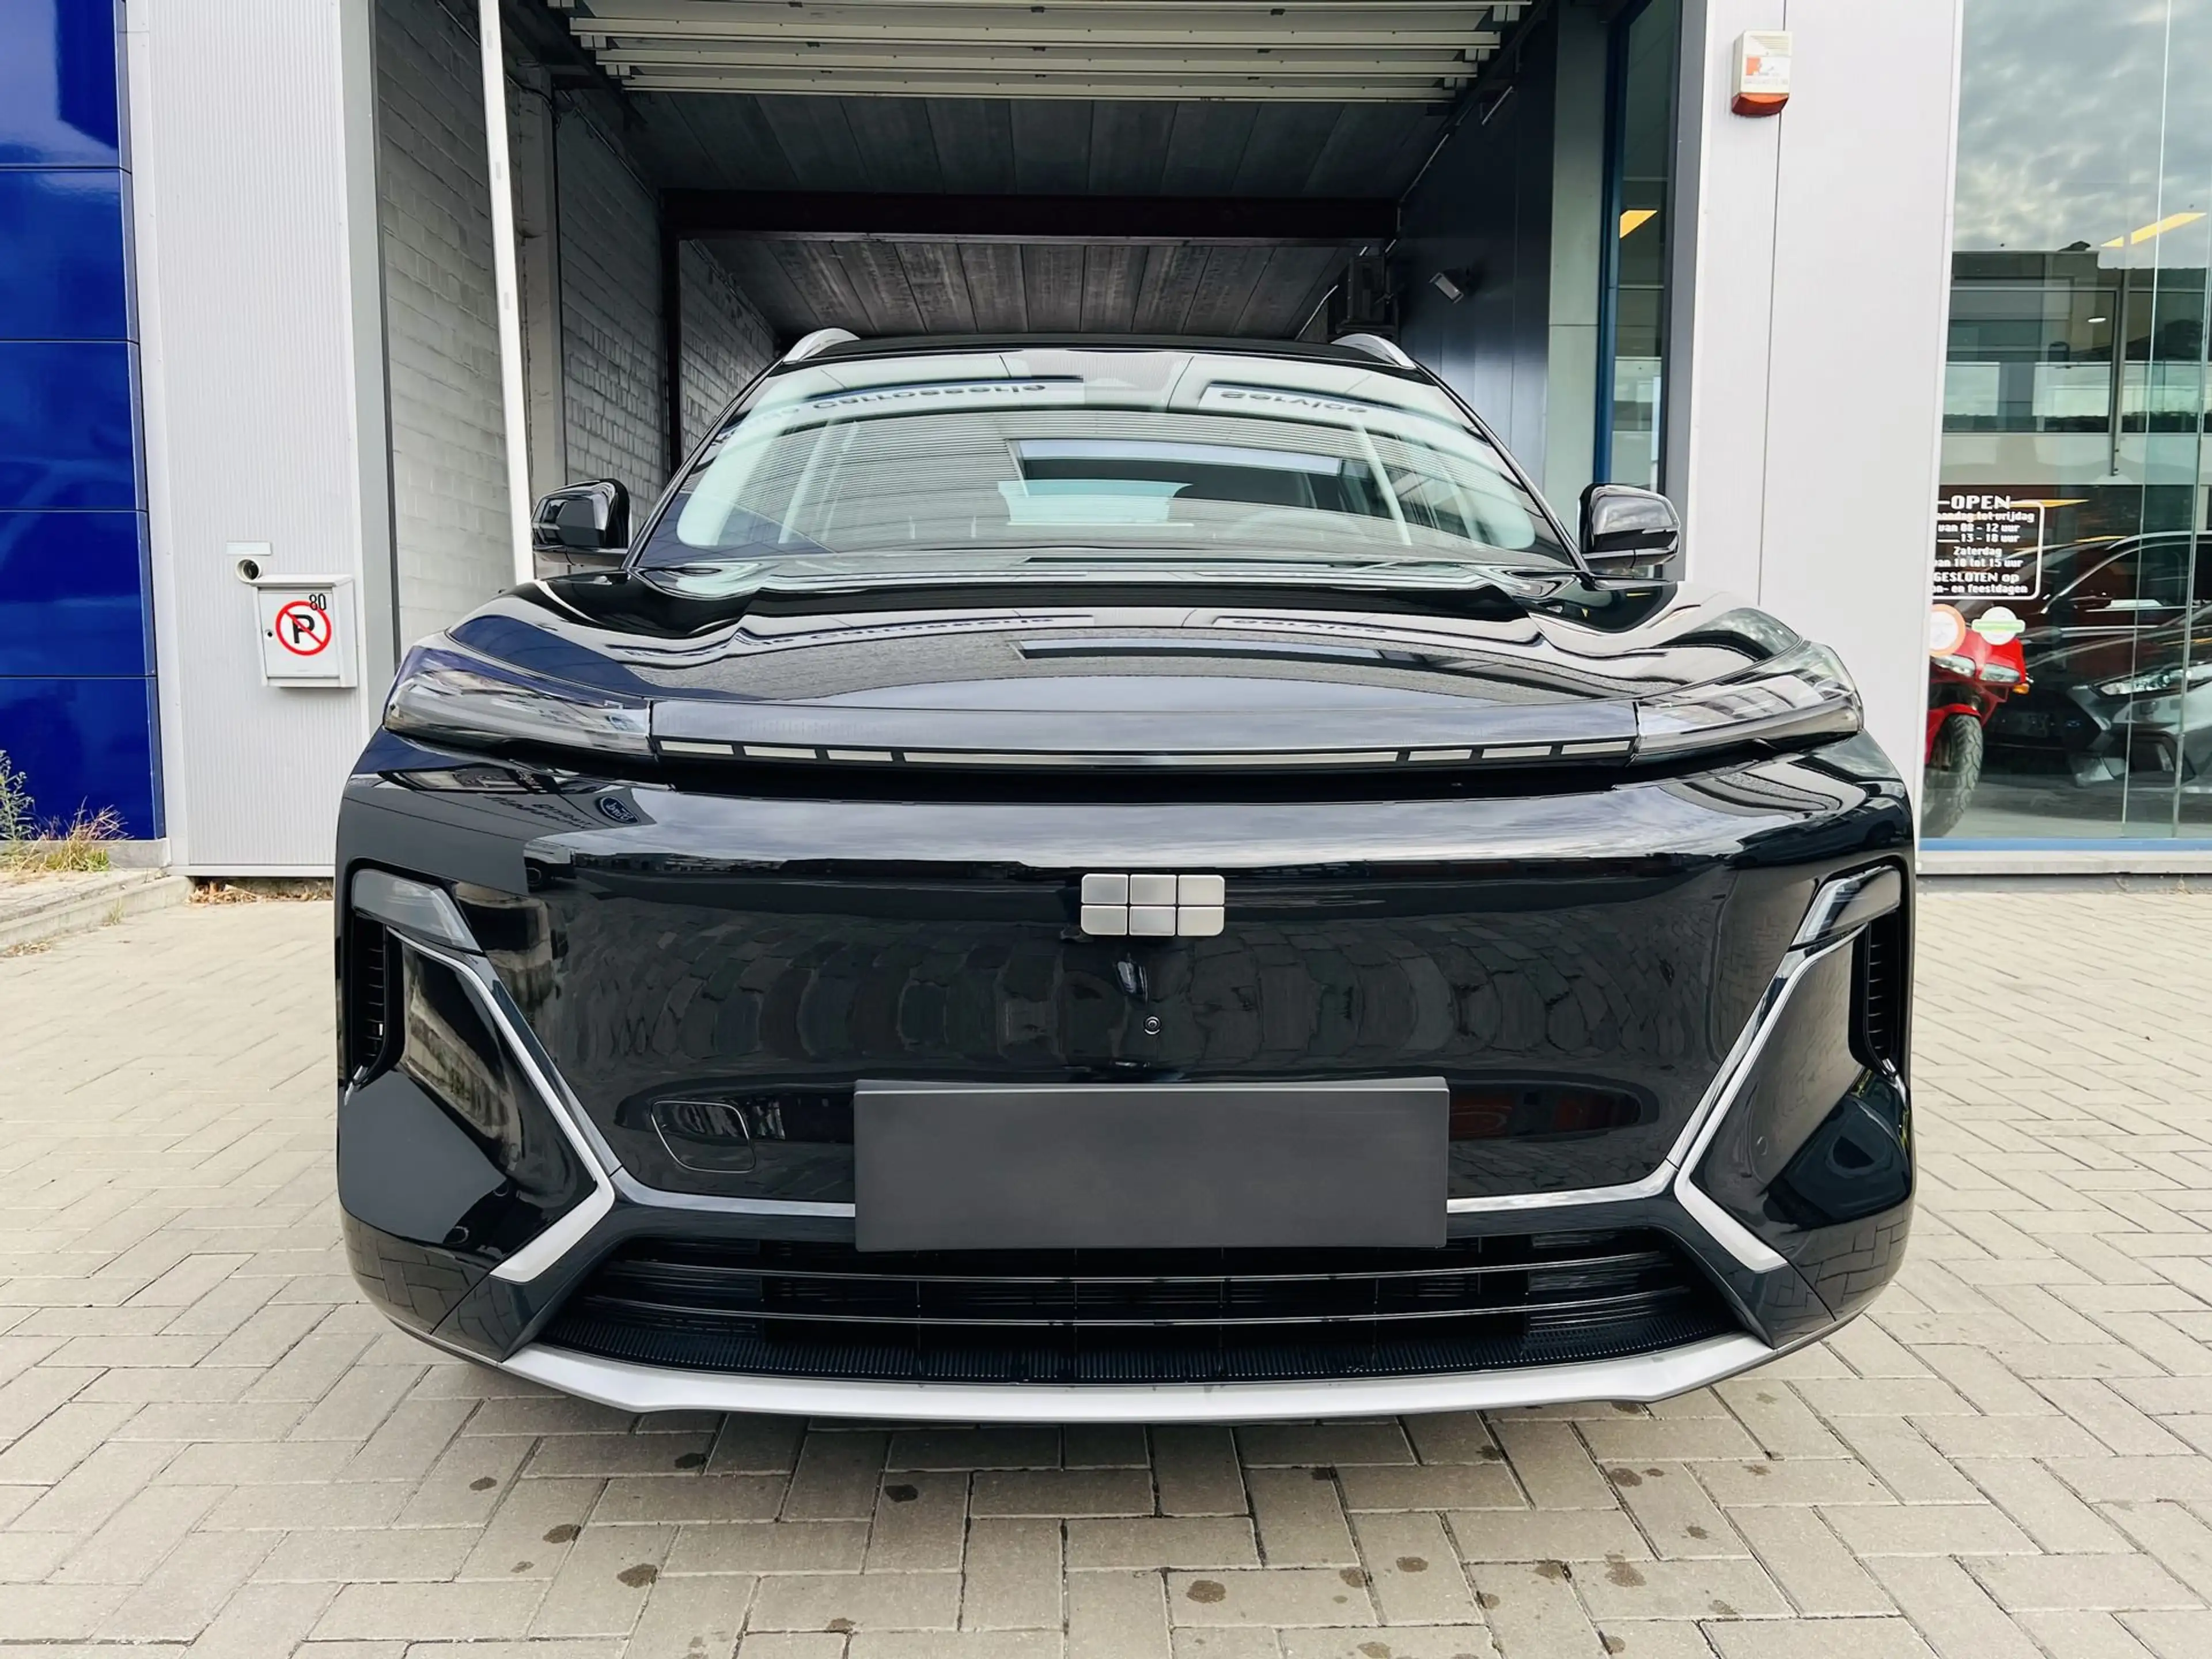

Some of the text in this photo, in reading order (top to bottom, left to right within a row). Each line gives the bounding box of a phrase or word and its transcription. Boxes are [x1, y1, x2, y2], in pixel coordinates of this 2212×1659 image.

[1950, 495, 2011, 510] OPEN
[1936, 511, 2035, 523] aandag tot vrijdag
[1938, 524, 1958, 532] van
[1986, 523, 1999, 532] 12
[1960, 533, 1974, 542] 13
[1986, 533, 1999, 542] 18
[1953, 546, 2002, 558] Zaterdag
[1954, 559, 1967, 567] 10
[1969, 559, 1986, 567] tot
[1989, 559, 2002, 567] 15
[1933, 571, 2020, 584] GESLOTEN op
[1967, 584, 2028, 595] feestdagen
[309, 593, 327, 611] 80
[291, 613, 315, 644] P
